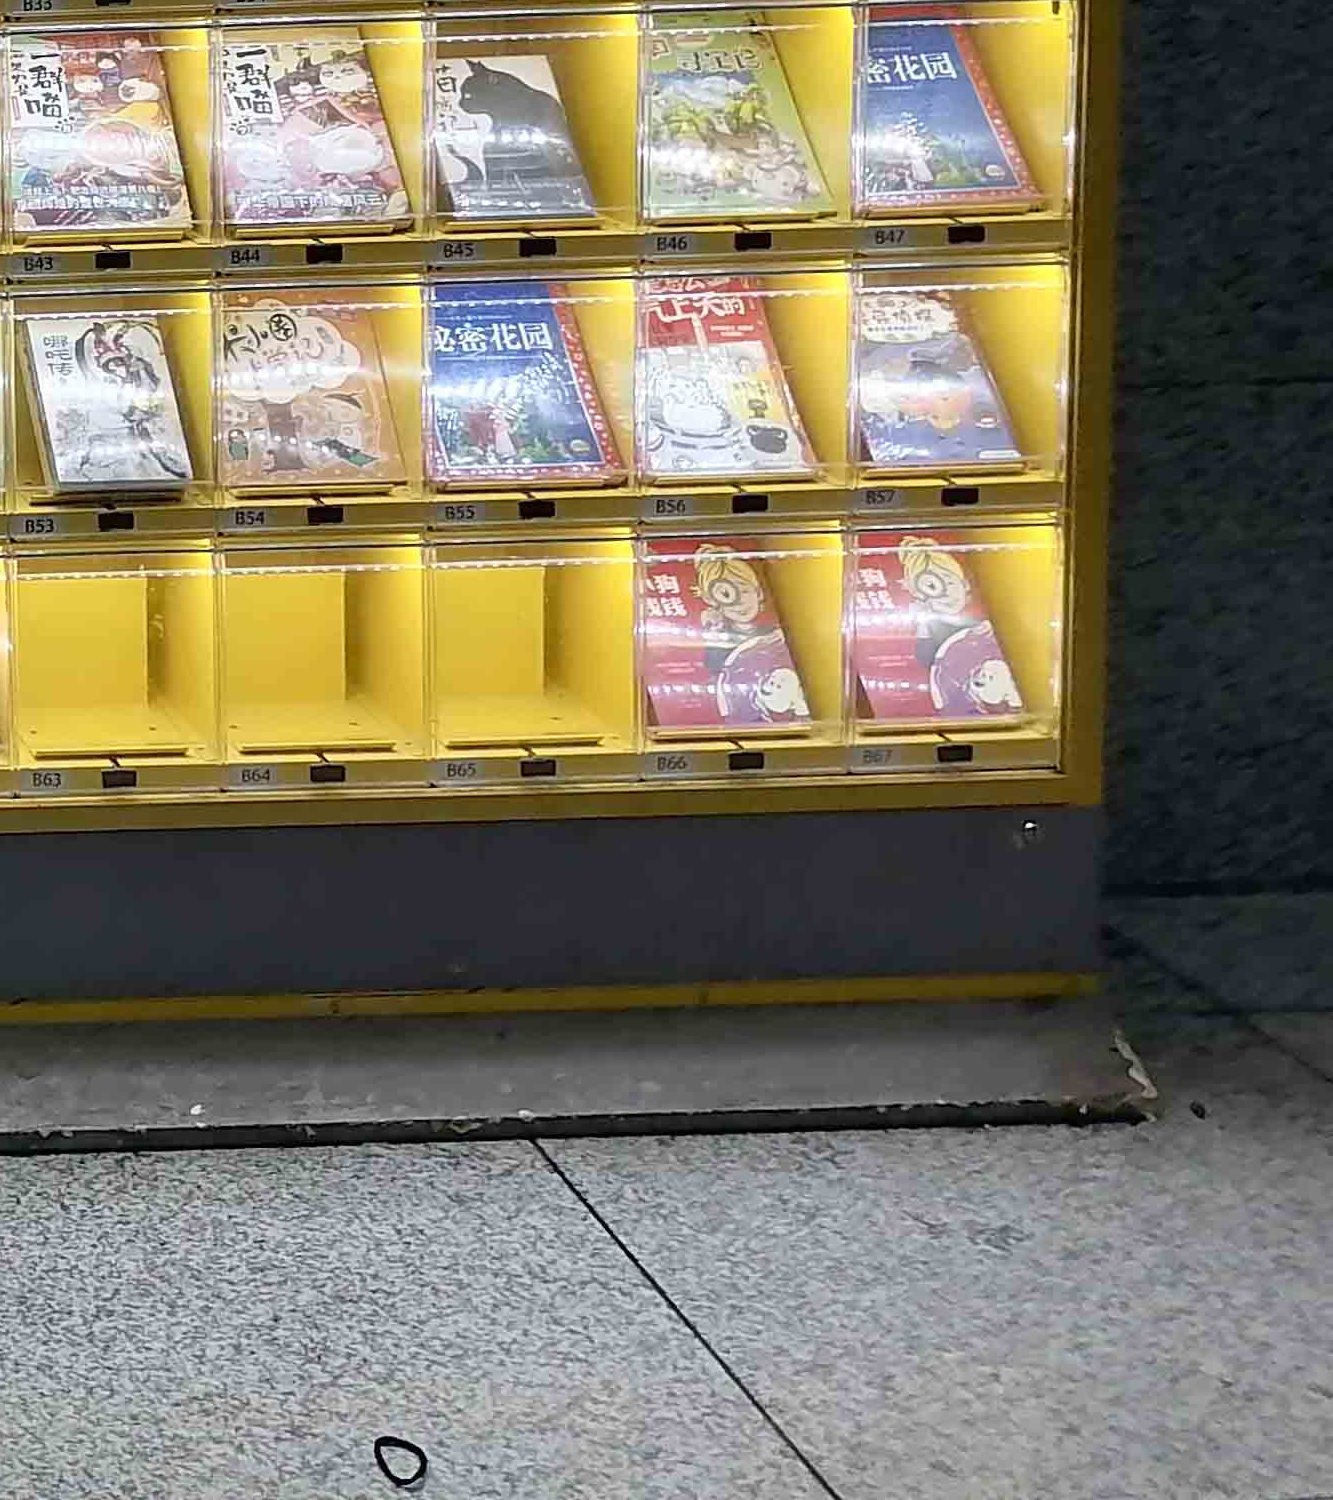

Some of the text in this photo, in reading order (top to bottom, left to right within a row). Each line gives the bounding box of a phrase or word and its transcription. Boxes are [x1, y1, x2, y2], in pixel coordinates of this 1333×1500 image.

[24, 52, 65, 119] 一群喵
[234, 47, 274, 116] 一群喵
[656, 236, 688, 252] B46
[444, 506, 476, 521] B55
[655, 499, 687, 515] B56
[234, 510, 265, 526] B54
[24, 520, 55, 536] B53
[446, 762, 477, 778] B65
[656, 755, 689, 771] B66
[32, 772, 62, 788] B63
[240, 768, 271, 784] B64
